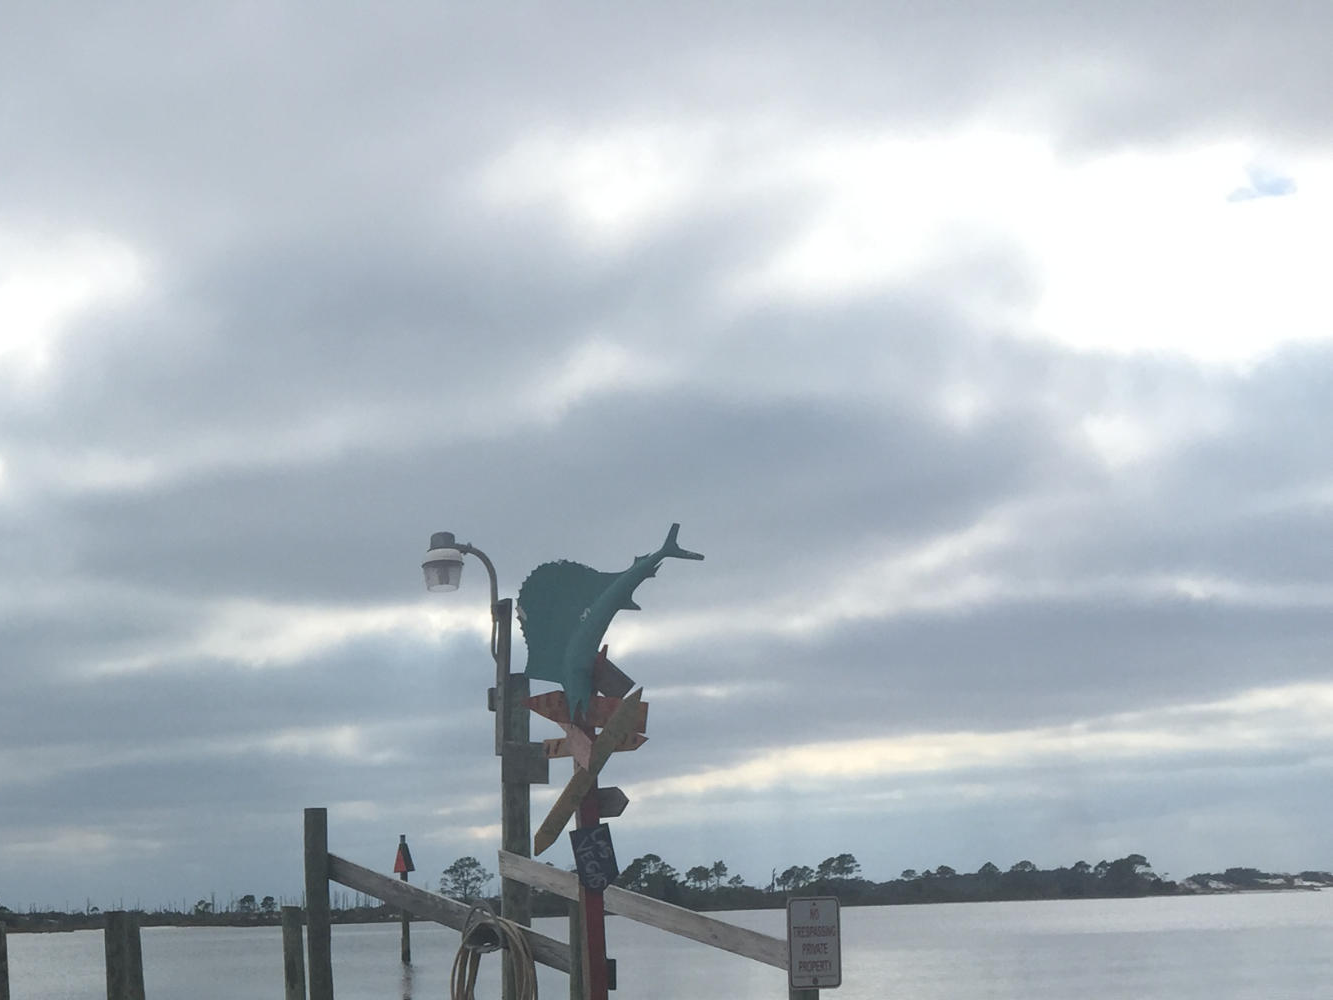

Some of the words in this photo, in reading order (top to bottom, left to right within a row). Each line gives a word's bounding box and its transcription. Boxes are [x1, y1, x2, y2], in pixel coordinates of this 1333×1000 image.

[576, 836, 607, 888] VEGAS
[810, 908, 820, 920] NO
[793, 925, 836, 938] TRESPASSING
[802, 943, 828, 955] PRIVATE
[798, 960, 831, 972] PROPERTY
